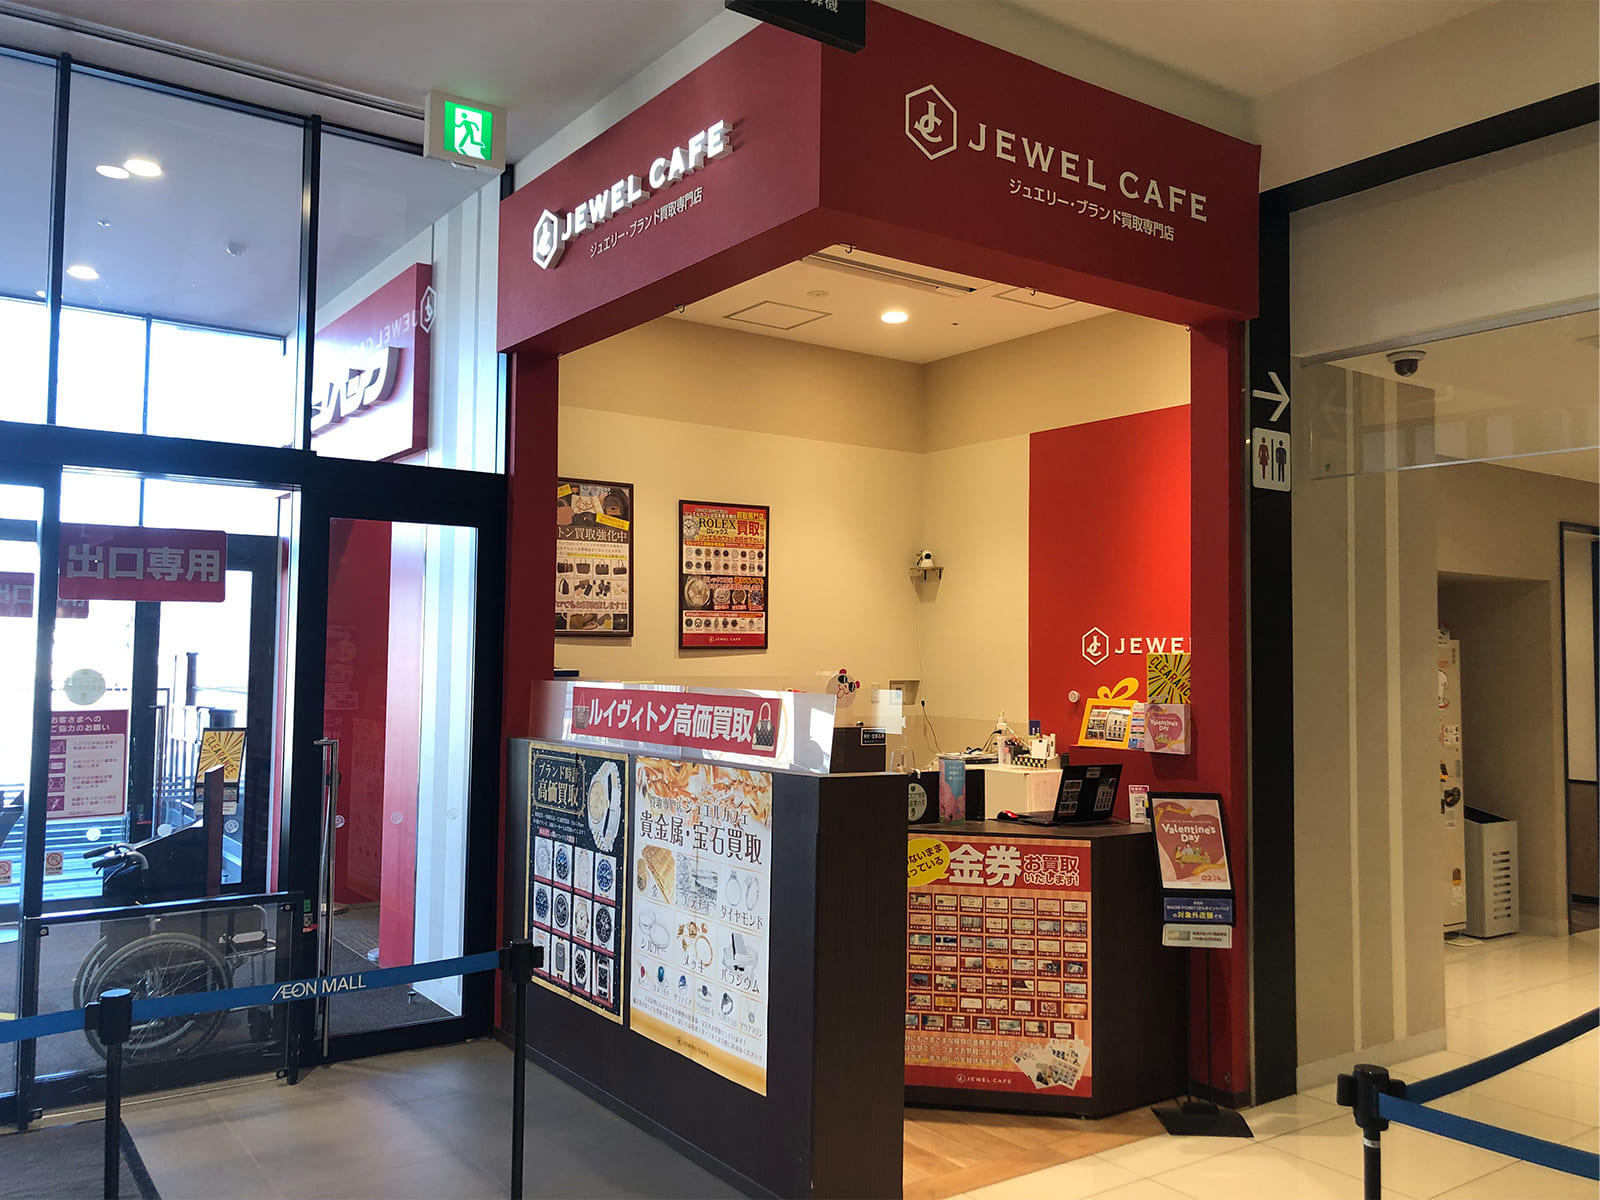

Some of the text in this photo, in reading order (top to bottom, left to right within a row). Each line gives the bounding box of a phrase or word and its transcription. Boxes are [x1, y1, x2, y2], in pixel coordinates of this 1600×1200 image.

[561, 118, 730, 242] JEWEL CAFE
[968, 122, 1208, 223] JEWEL CAFE
[589, 186, 704, 258] ジュエリー・ブランド買取専門店
[1009, 178, 1175, 242] ジュエリー・ブランド買取専門店
[558, 527, 628, 543] トン買取強化中
[699, 518, 736, 529] ROLEX
[737, 520, 760, 536] 買取
[65, 543, 221, 584] 出口専用
[1115, 637, 1191, 654] JEWE
[1150, 656, 1191, 698] CLEARANC
[51, 715, 101, 724] お客さまへの
[589, 698, 754, 743] ルイヴィトン高価買取
[205, 735, 237, 776] CLEARANCE
[538, 762, 579, 783] ブランド時計
[538, 778, 579, 807] 高価買取
[640, 810, 762, 865] 貴金属・宝石買取
[1161, 823, 1216, 835] Valentine's
[1181, 834, 1200, 843] Day
[907, 857, 944, 878] っている
[949, 844, 1022, 886] 金券
[1024, 854, 1079, 874] お買取
[720, 904, 763, 930] ダイヤモンド
[321, 974, 367, 994] MALL
[720, 968, 760, 994] パラジウム
